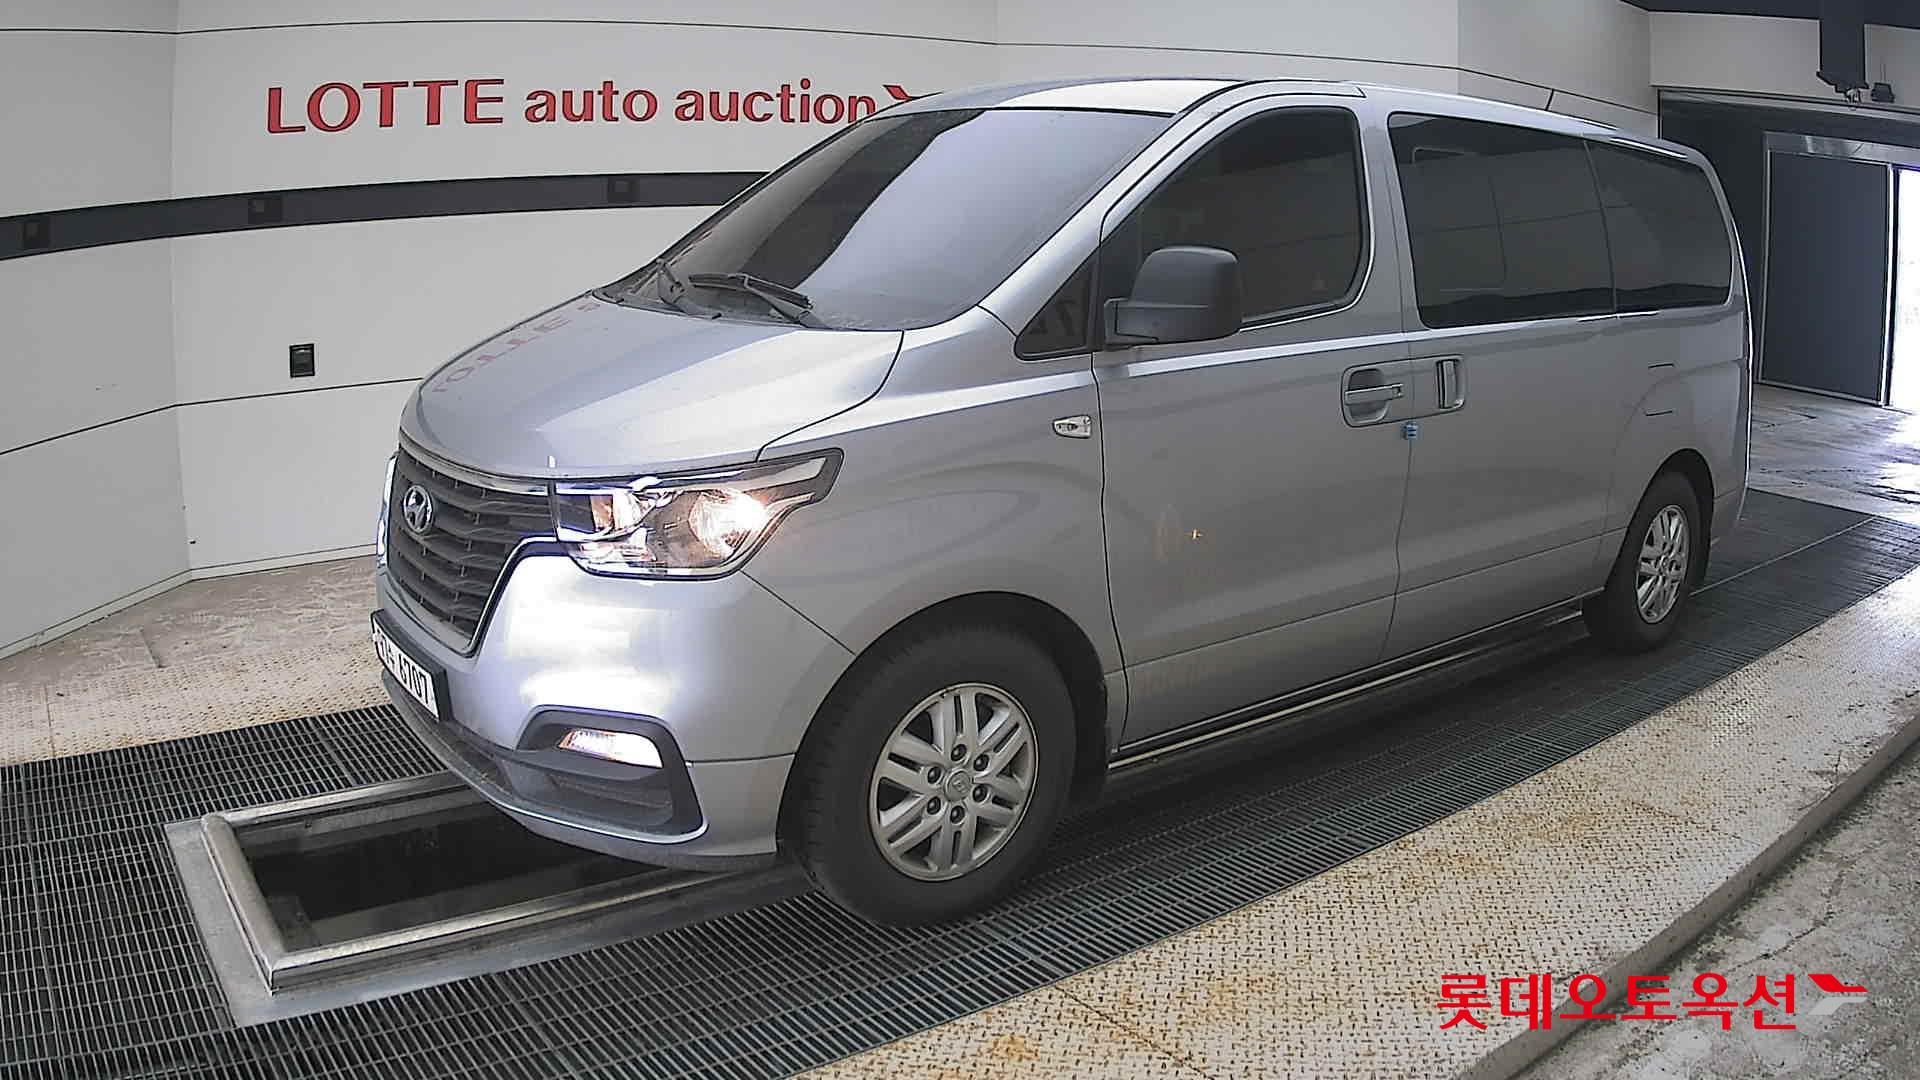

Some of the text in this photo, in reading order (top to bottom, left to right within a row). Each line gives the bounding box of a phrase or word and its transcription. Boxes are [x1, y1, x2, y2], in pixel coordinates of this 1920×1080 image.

[266, 78, 877, 134] LOTTE auto auction
